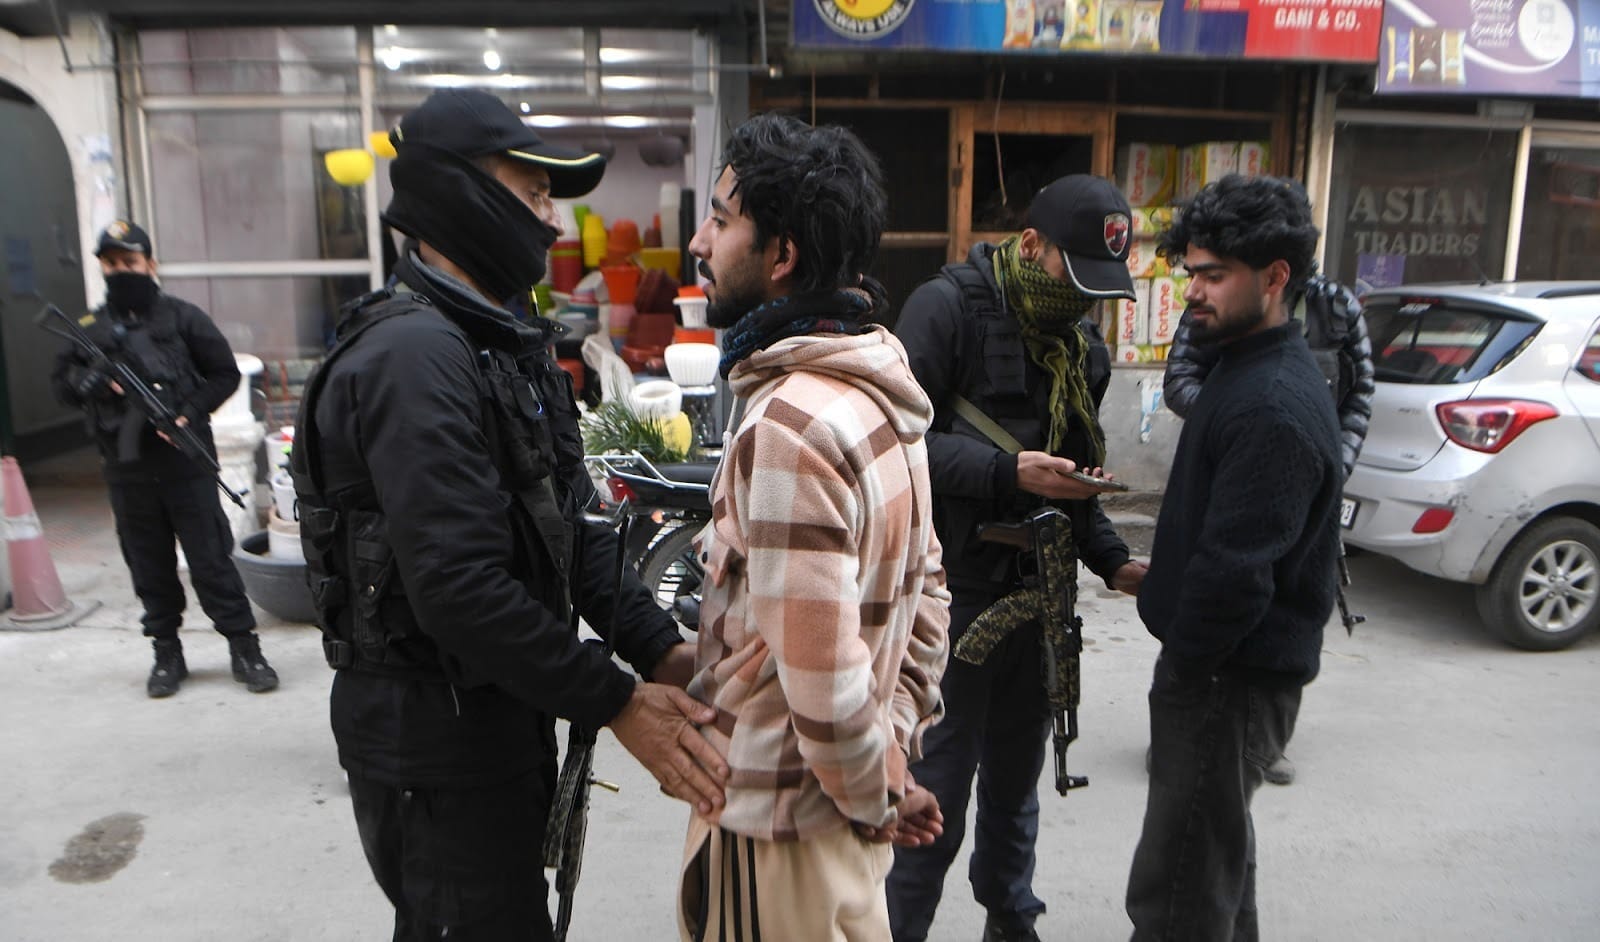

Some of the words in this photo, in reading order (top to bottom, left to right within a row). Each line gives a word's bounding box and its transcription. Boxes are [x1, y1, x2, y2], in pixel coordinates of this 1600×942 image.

[1275, 7, 1314, 30] GANI
[1317, 8, 1330, 31] &
[1349, 184, 1489, 225] ASIAN
[1354, 231, 1481, 257] TRADERS
[1156, 283, 1171, 338] fortune
